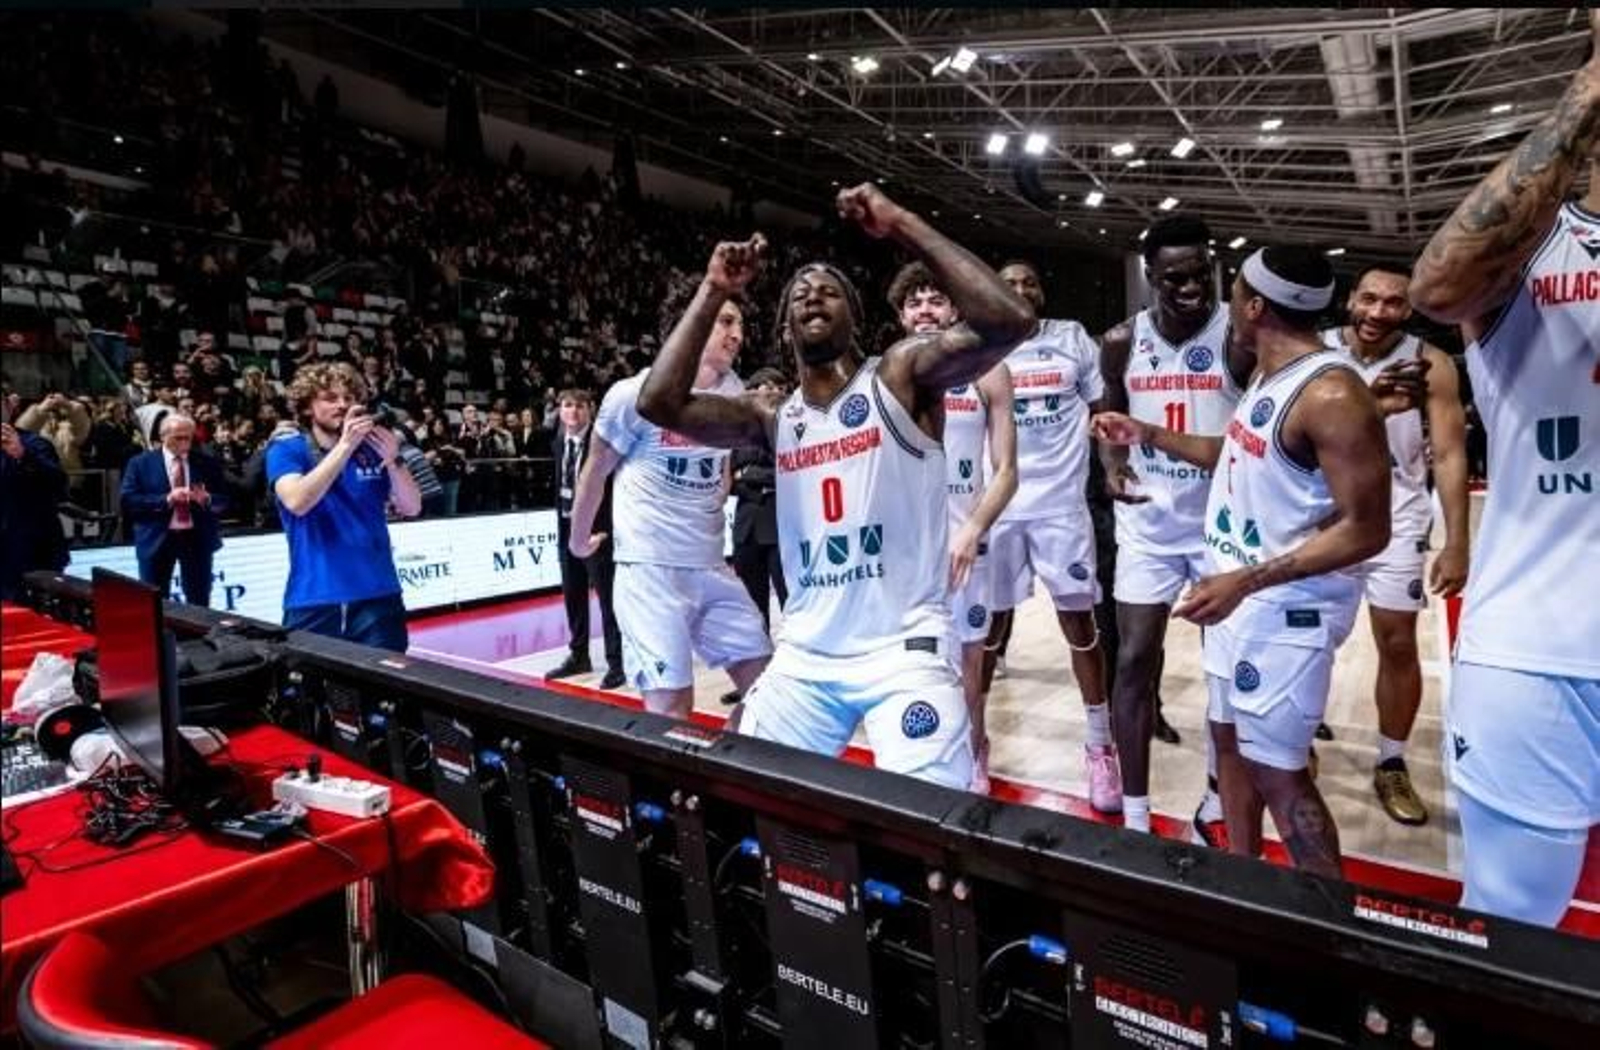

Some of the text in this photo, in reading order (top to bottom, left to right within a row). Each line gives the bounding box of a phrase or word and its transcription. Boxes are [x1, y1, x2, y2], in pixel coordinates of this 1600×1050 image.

[1532, 270, 1600, 309] PALLAC
[1165, 402, 1186, 434] 11
[822, 477, 844, 523] 0
[503, 532, 557, 548] MATCH
[776, 963, 870, 1017] BERTELE.EU
